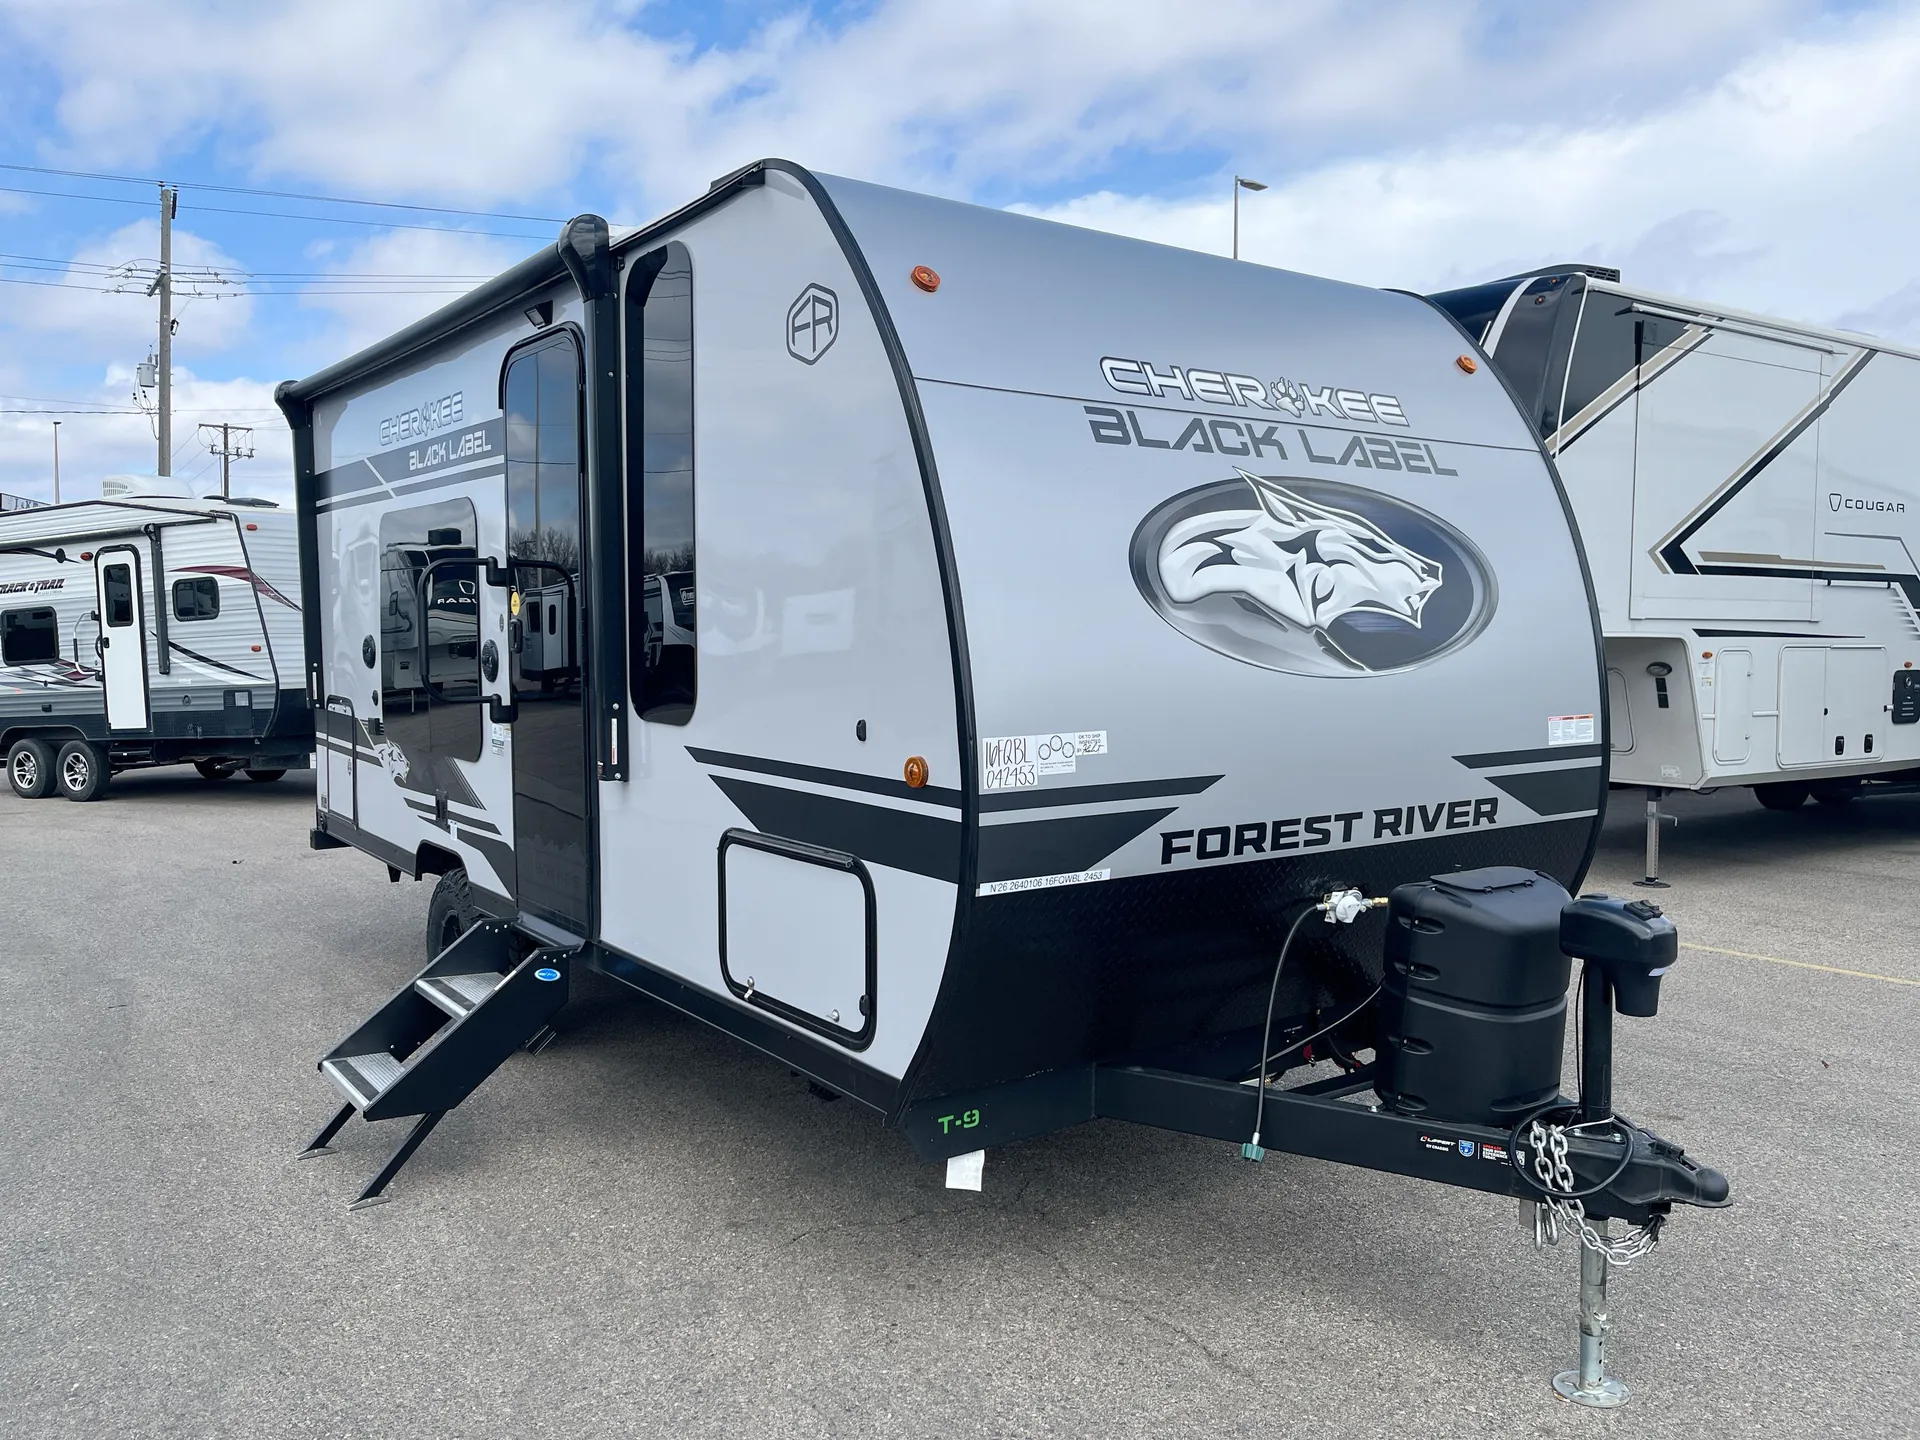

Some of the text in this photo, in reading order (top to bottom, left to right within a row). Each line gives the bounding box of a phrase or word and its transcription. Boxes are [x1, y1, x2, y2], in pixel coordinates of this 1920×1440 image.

[409, 429, 492, 471] BLACK LABEL
[1083, 405, 1459, 477] BLACK LABEL
[1844, 498, 1905, 513] COUGAR
[34, 578, 65, 594] TRAIL
[1159, 797, 1499, 866] FOREST RIVER
[1009, 878, 1043, 891] 2640106
[1045, 873, 1082, 886] 16FQWBL
[1083, 871, 1103, 881] 2453
[937, 1109, 980, 1134] T-9
